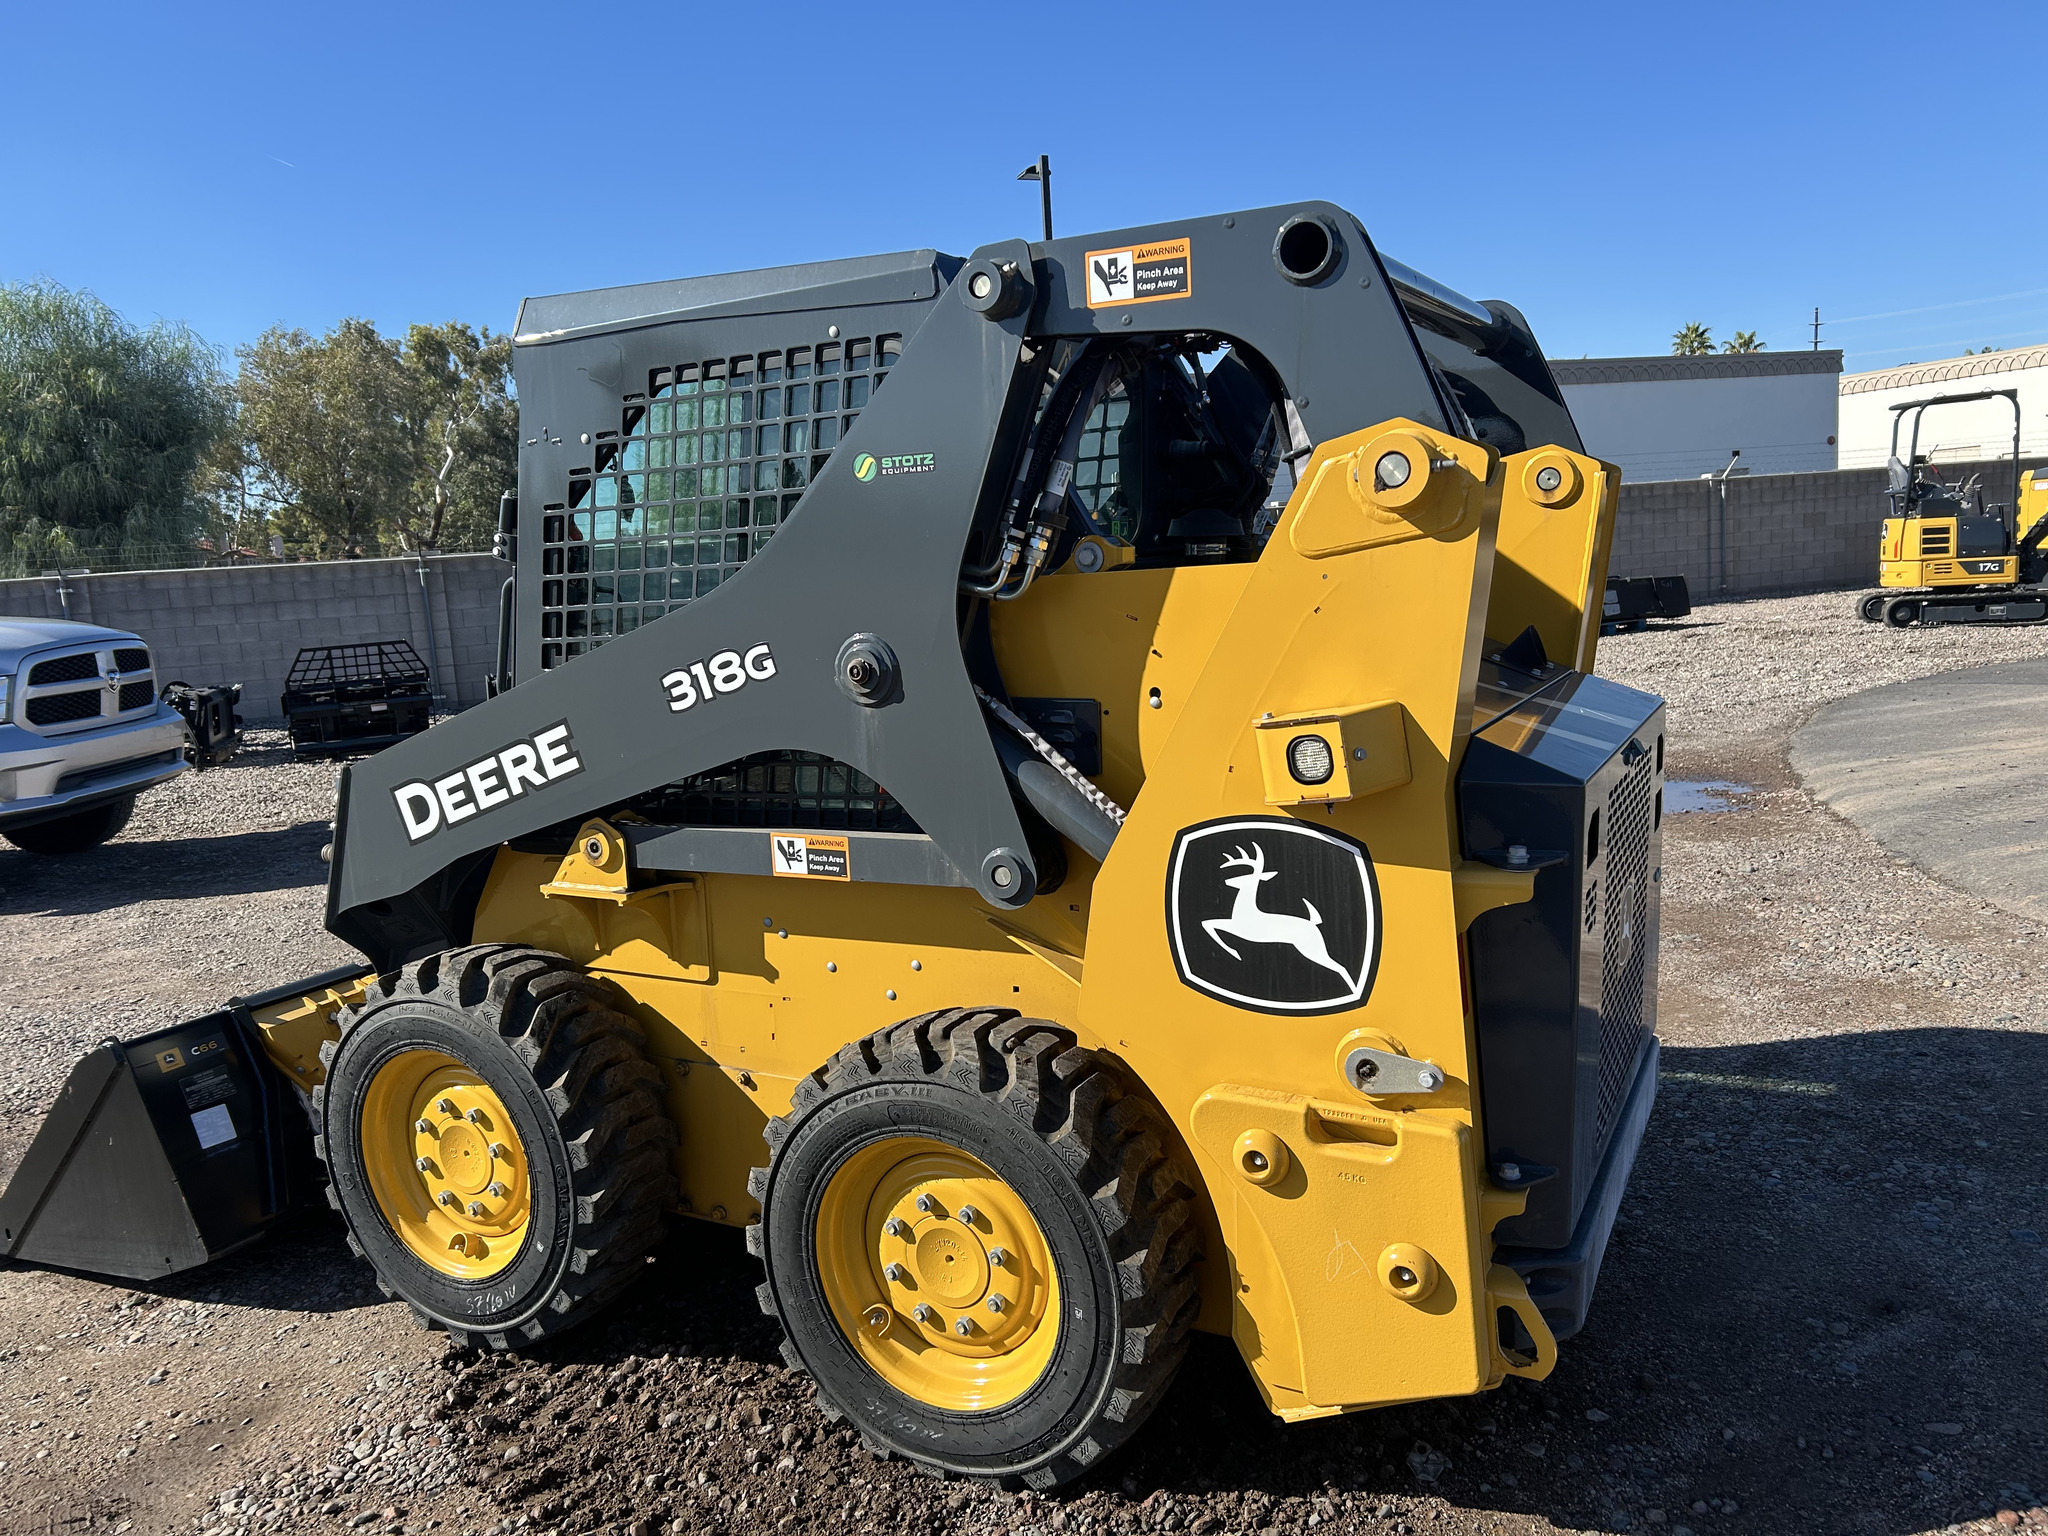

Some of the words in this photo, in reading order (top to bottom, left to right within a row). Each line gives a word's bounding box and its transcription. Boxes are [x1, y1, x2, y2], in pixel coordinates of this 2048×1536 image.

[1144, 245, 1185, 257] WARNING
[1136, 268, 1161, 279] Pinch
[1163, 266, 1184, 276] Area
[1137, 282, 1156, 291] Keep
[1157, 279, 1177, 289] Away
[881, 453, 934, 468] STOTZ
[882, 465, 935, 475] EQUIPMENT
[1979, 562, 1999, 571] 17G
[662, 644, 777, 711] 318G
[394, 724, 580, 840] DEERE
[815, 839, 845, 848] WARNING
[809, 853, 828, 862] Pinch
[828, 855, 845, 864] Area
[809, 863, 824, 871] Keep
[824, 864, 840, 873] Away
[191, 1041, 218, 1055] C66
